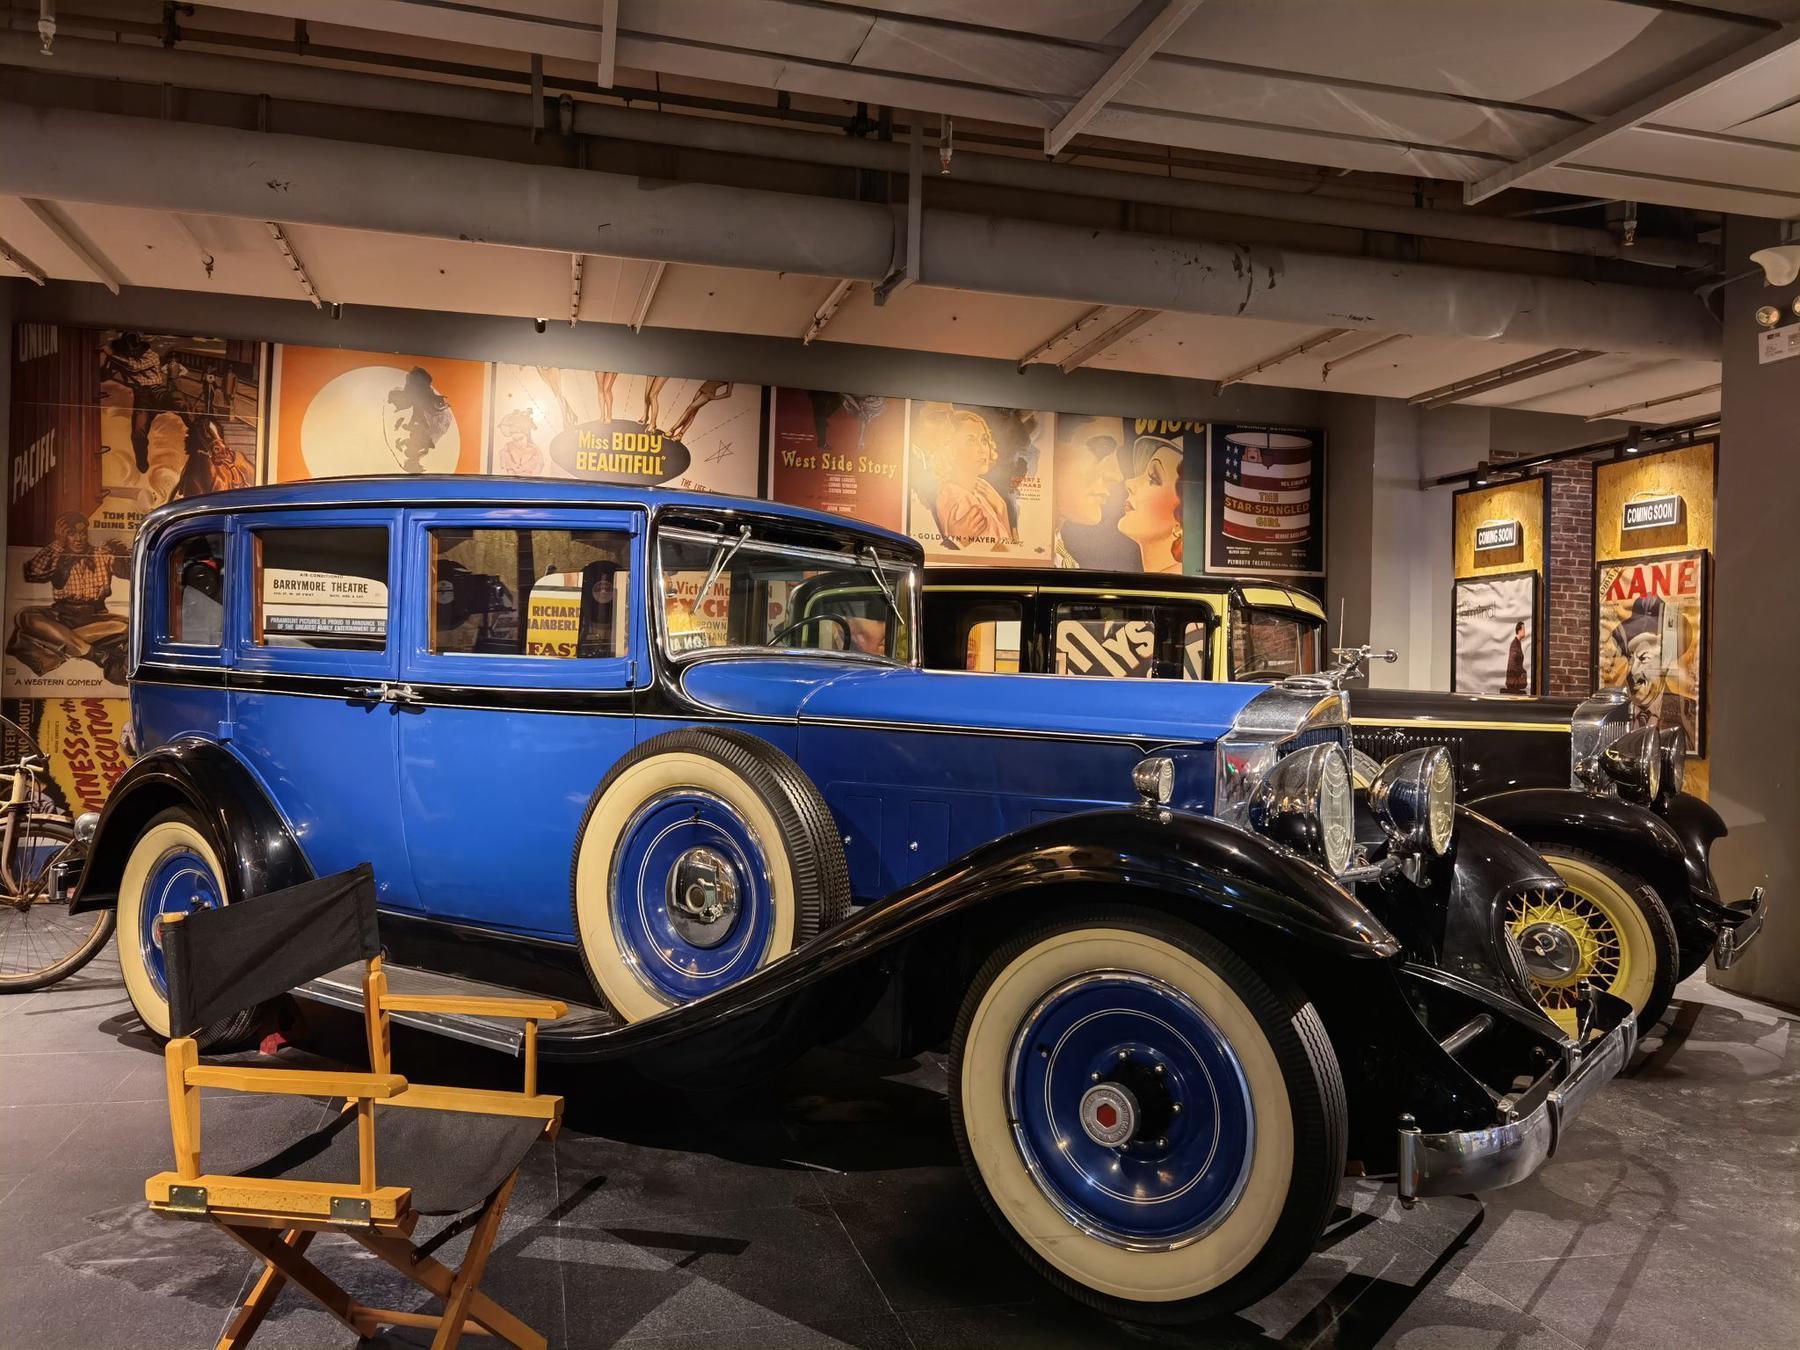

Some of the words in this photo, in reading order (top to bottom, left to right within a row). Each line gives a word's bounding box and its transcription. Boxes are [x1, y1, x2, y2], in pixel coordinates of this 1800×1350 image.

[612, 432, 662, 454] BODY
[781, 450, 816, 469] West
[821, 453, 853, 472] Side
[858, 457, 897, 478] Story
[1259, 492, 1279, 502] THE
[102, 511, 125, 521] TOM
[1627, 505, 1653, 524] COMING
[1653, 502, 1673, 520] SOON
[93, 521, 124, 530] DOING
[1255, 516, 1281, 527] GIRL
[968, 535, 996, 543] MAYER
[1478, 529, 1498, 545] COMING
[1498, 526, 1514, 542] SOON
[273, 579, 327, 591] BARRYMORE
[331, 581, 368, 593] THEATRE
[1605, 560, 1697, 601] KANE
[676, 581, 709, 595] Victr
[66, 679, 104, 687] COMEDY
[59, 699, 77, 713] th
